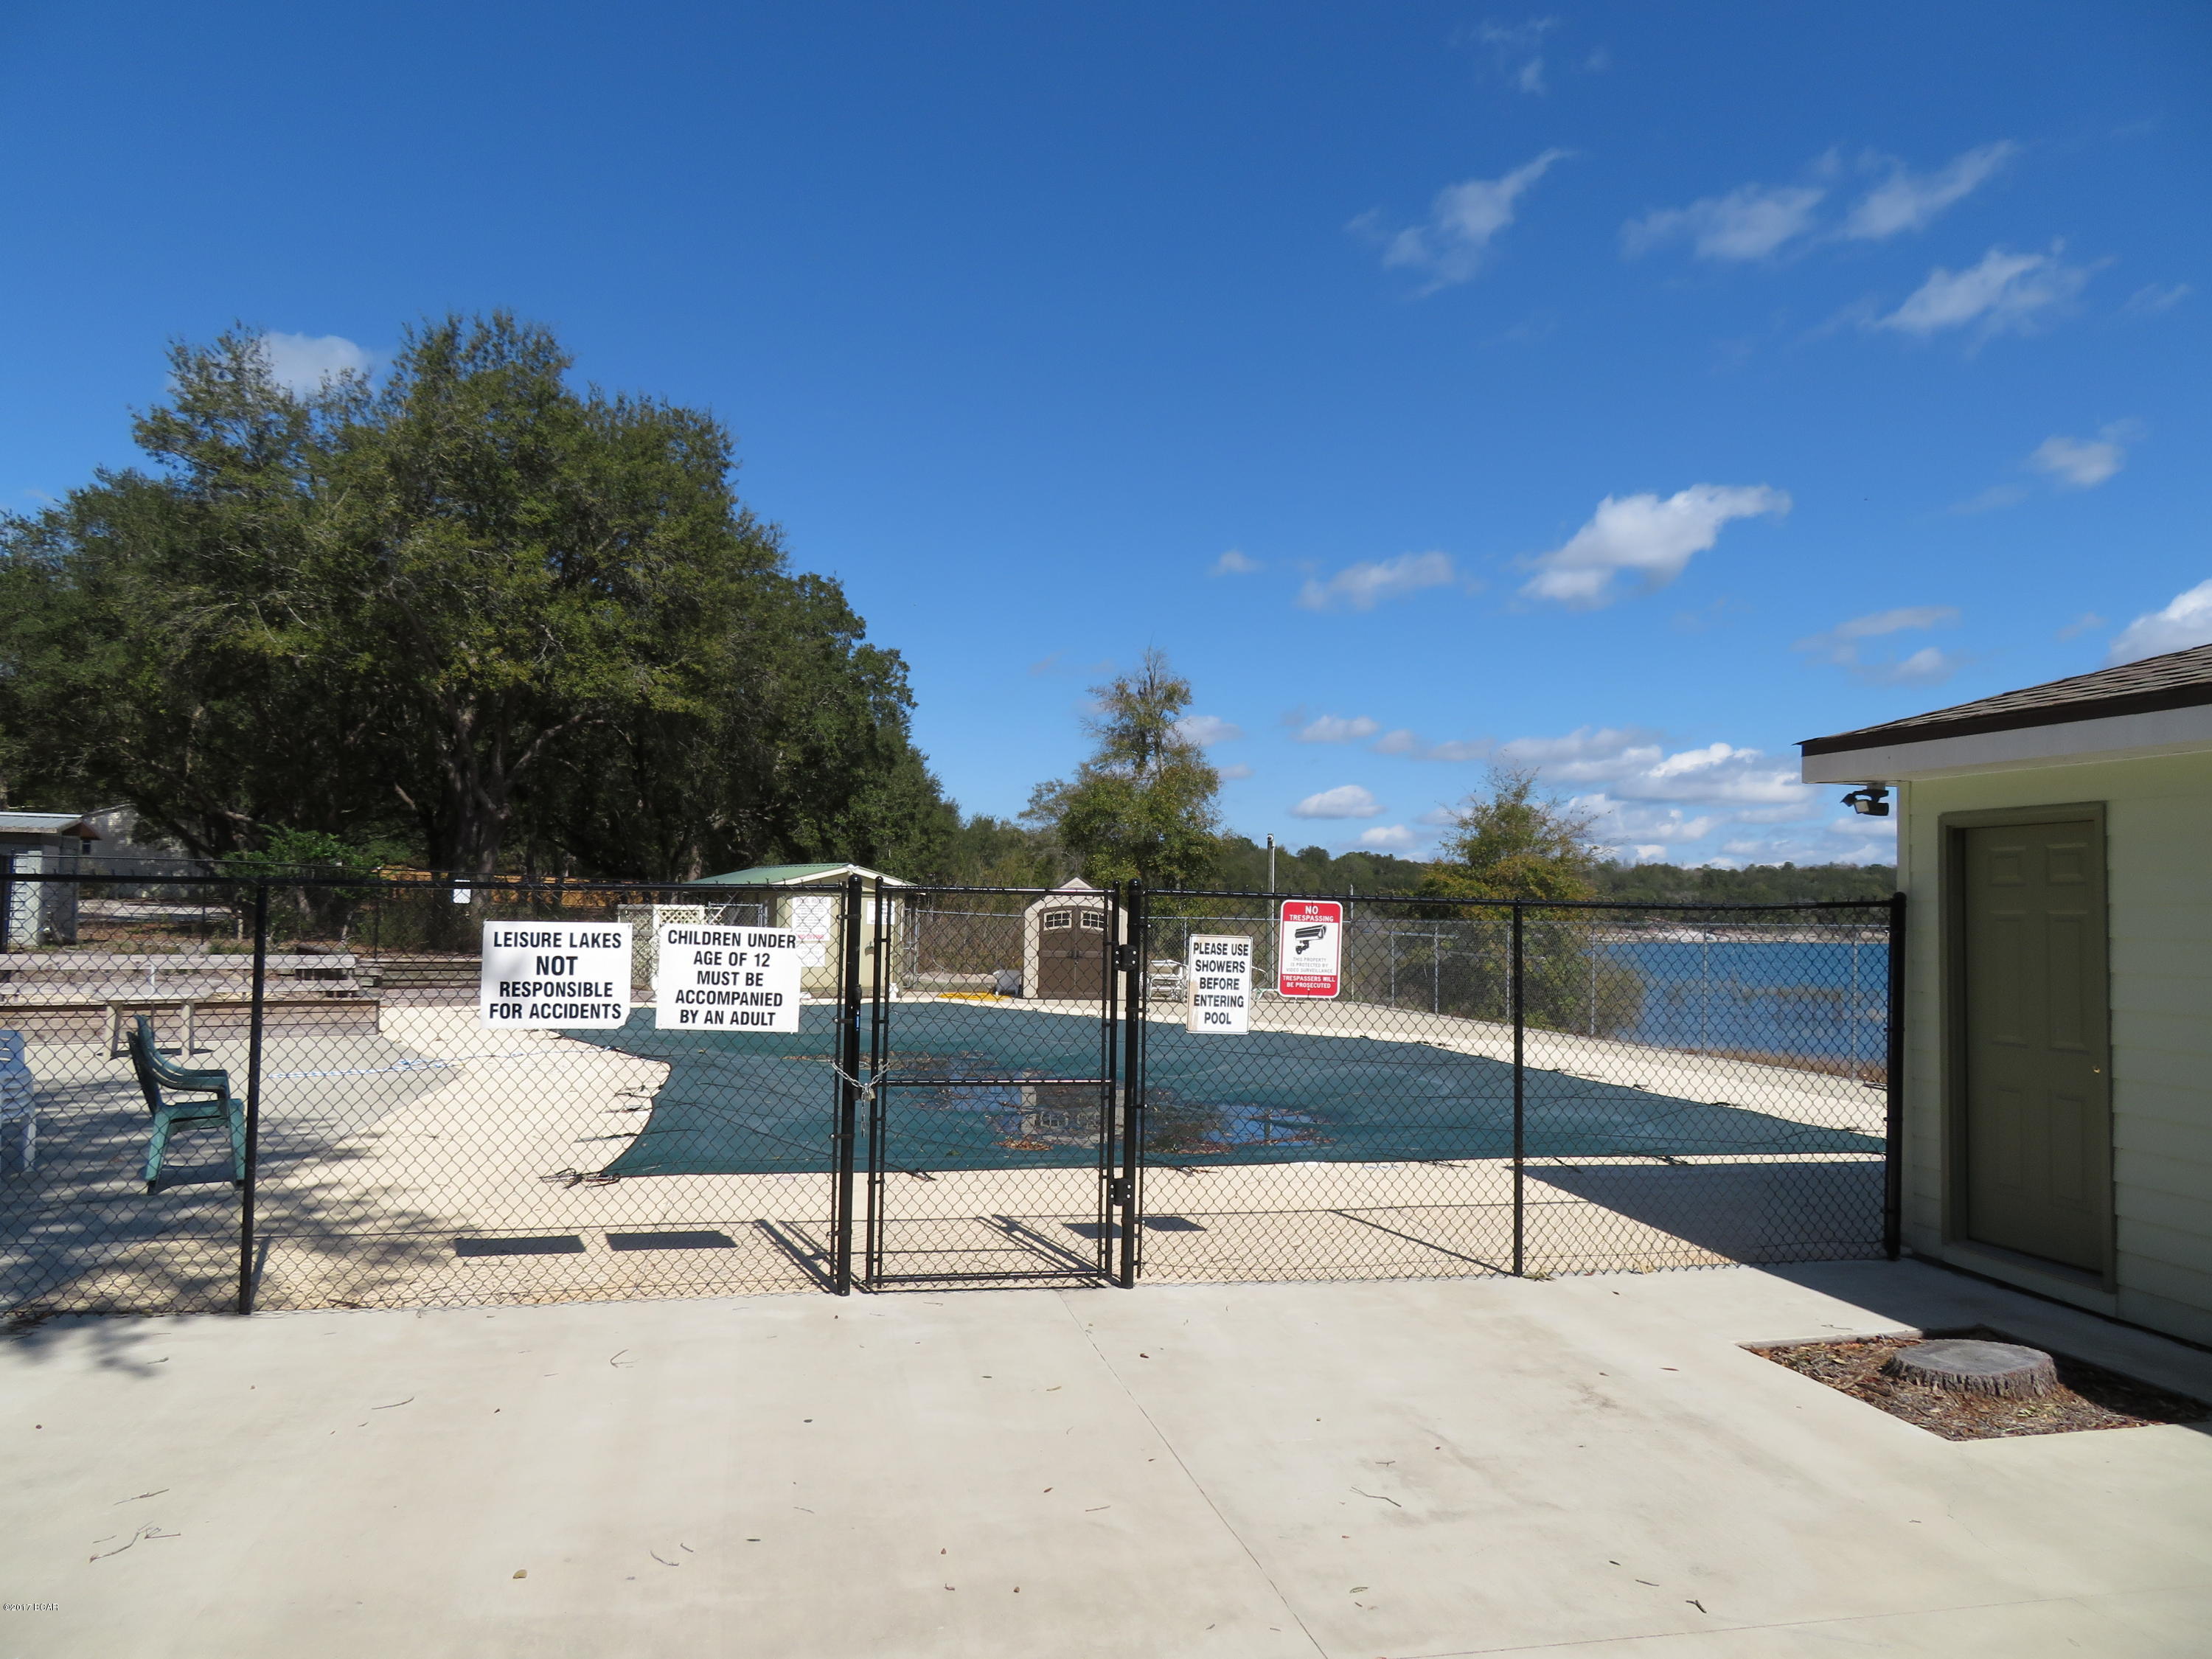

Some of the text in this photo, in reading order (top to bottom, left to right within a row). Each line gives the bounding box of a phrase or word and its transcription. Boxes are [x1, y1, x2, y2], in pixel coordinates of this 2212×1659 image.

[1305, 905, 1318, 914] NO
[493, 931, 622, 949] LEISURE LAKES
[668, 929, 796, 949] CHILDREN UNDER
[1193, 942, 1249, 956] PLEASE USE
[536, 955, 578, 976] NOT
[693, 950, 771, 967] AGE OF 12
[1195, 959, 1245, 973] SHOWERS
[697, 970, 764, 987] MUST BE
[1199, 977, 1239, 990] BEFORE
[499, 981, 613, 998] RESPONSIBLE
[675, 990, 783, 1007] ACCOMPANIED
[1193, 994, 1244, 1008] ENTERING
[490, 1003, 622, 1020] FOR ACCIDENTS
[680, 1009, 776, 1026] BY AN ADULT
[1204, 1012, 1231, 1025] POOL
